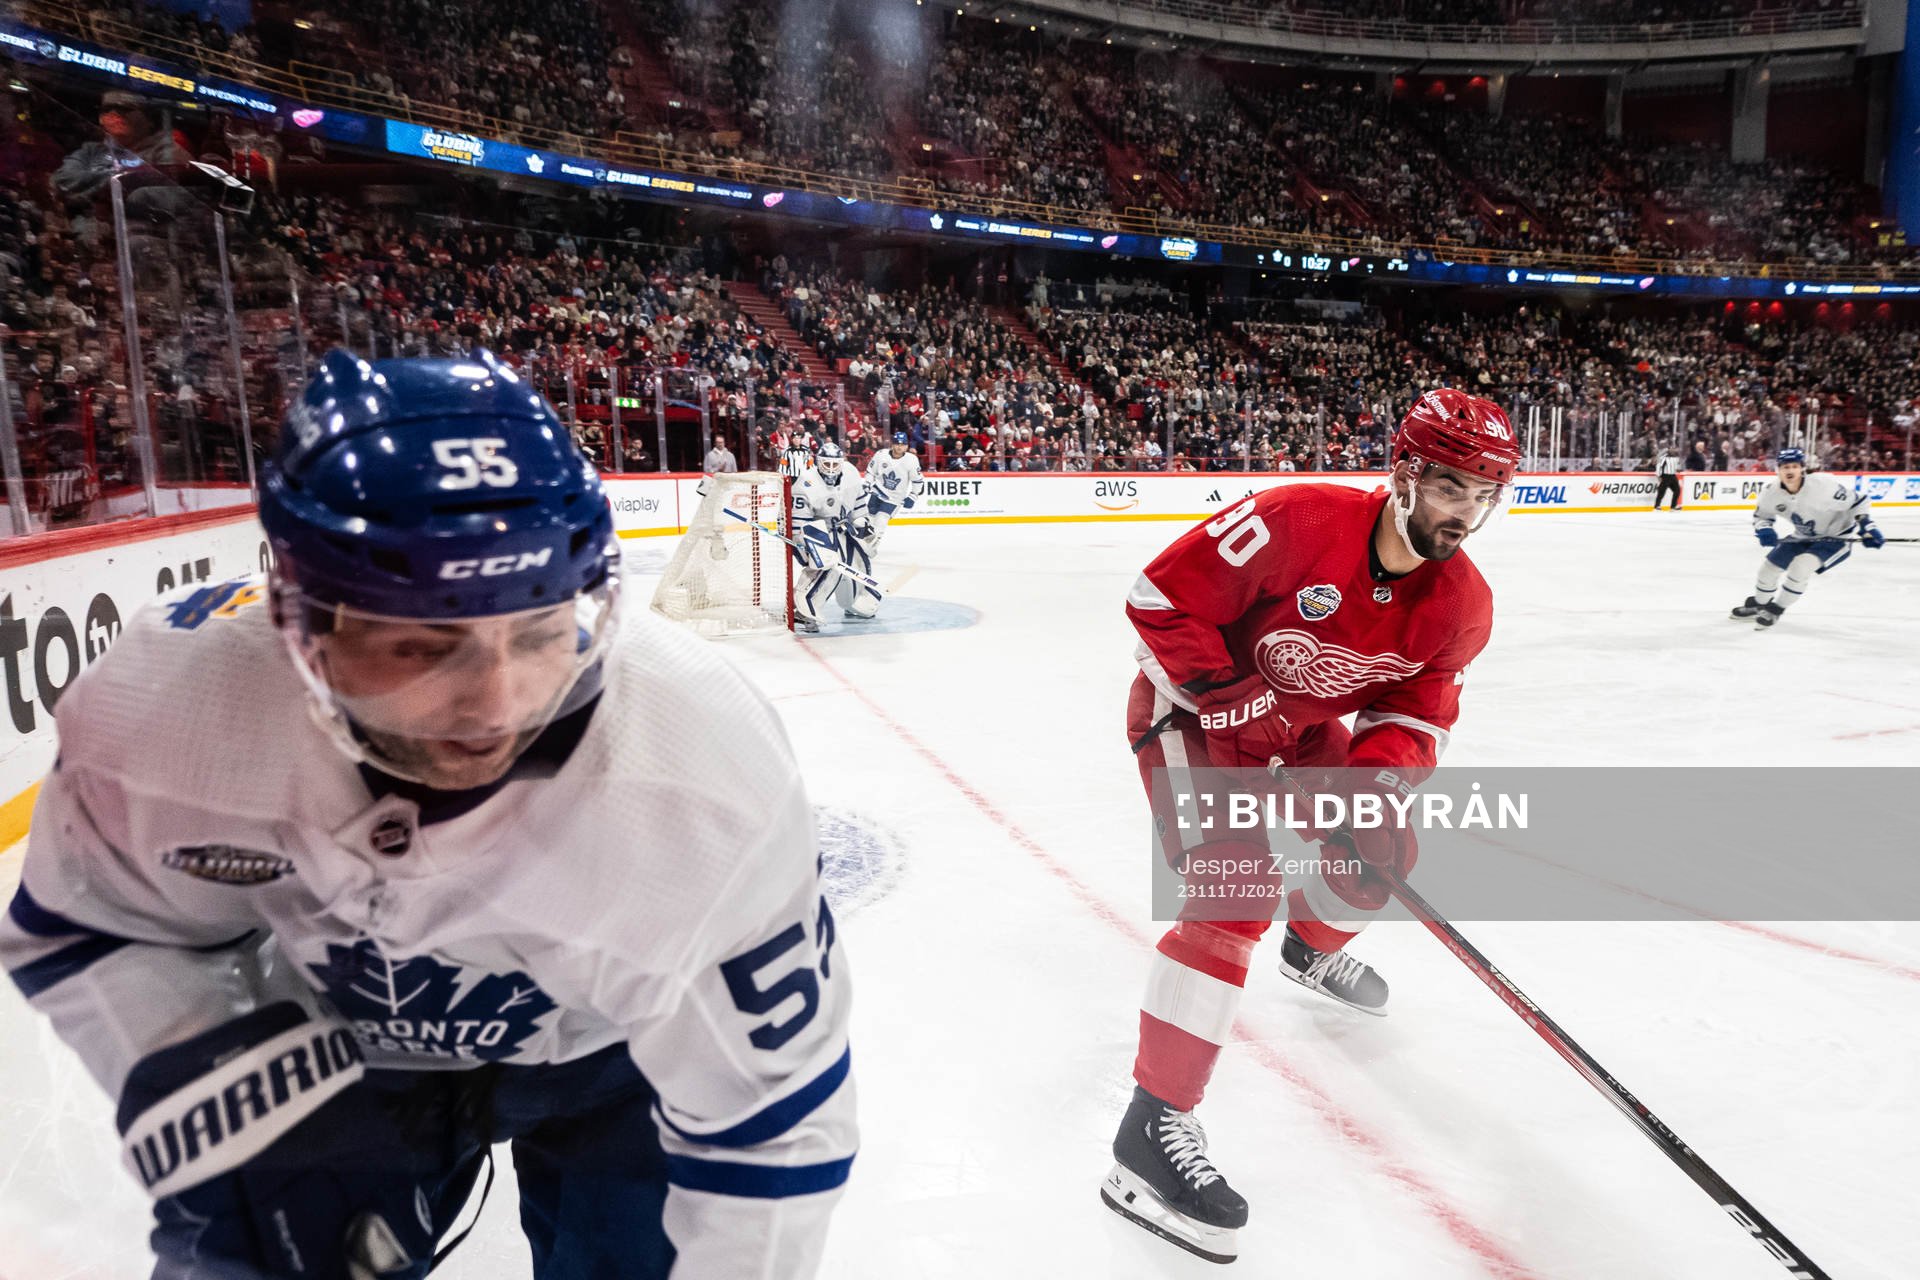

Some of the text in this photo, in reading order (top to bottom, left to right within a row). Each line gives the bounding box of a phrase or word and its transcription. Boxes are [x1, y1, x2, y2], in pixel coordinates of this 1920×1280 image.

[58, 45, 126, 76] GLOBAL
[128, 65, 195, 93] SERIES
[423, 132, 482, 156] GLOBAL
[606, 170, 650, 187] GLOBAL
[651, 177, 695, 193] SERIES
[1302, 256, 1331, 270] 10:27
[1485, 420, 1510, 441] 90
[431, 437, 519, 490] 55
[1095, 480, 1137, 497] aws
[1513, 486, 1567, 504] TENAL
[1694, 482, 1715, 500] CAT
[614, 497, 660, 513] viaplay
[438, 547, 553, 580] CCM
[1301, 589, 1340, 609] GLOBAL
[132, 1028, 364, 1188] WARRIO
